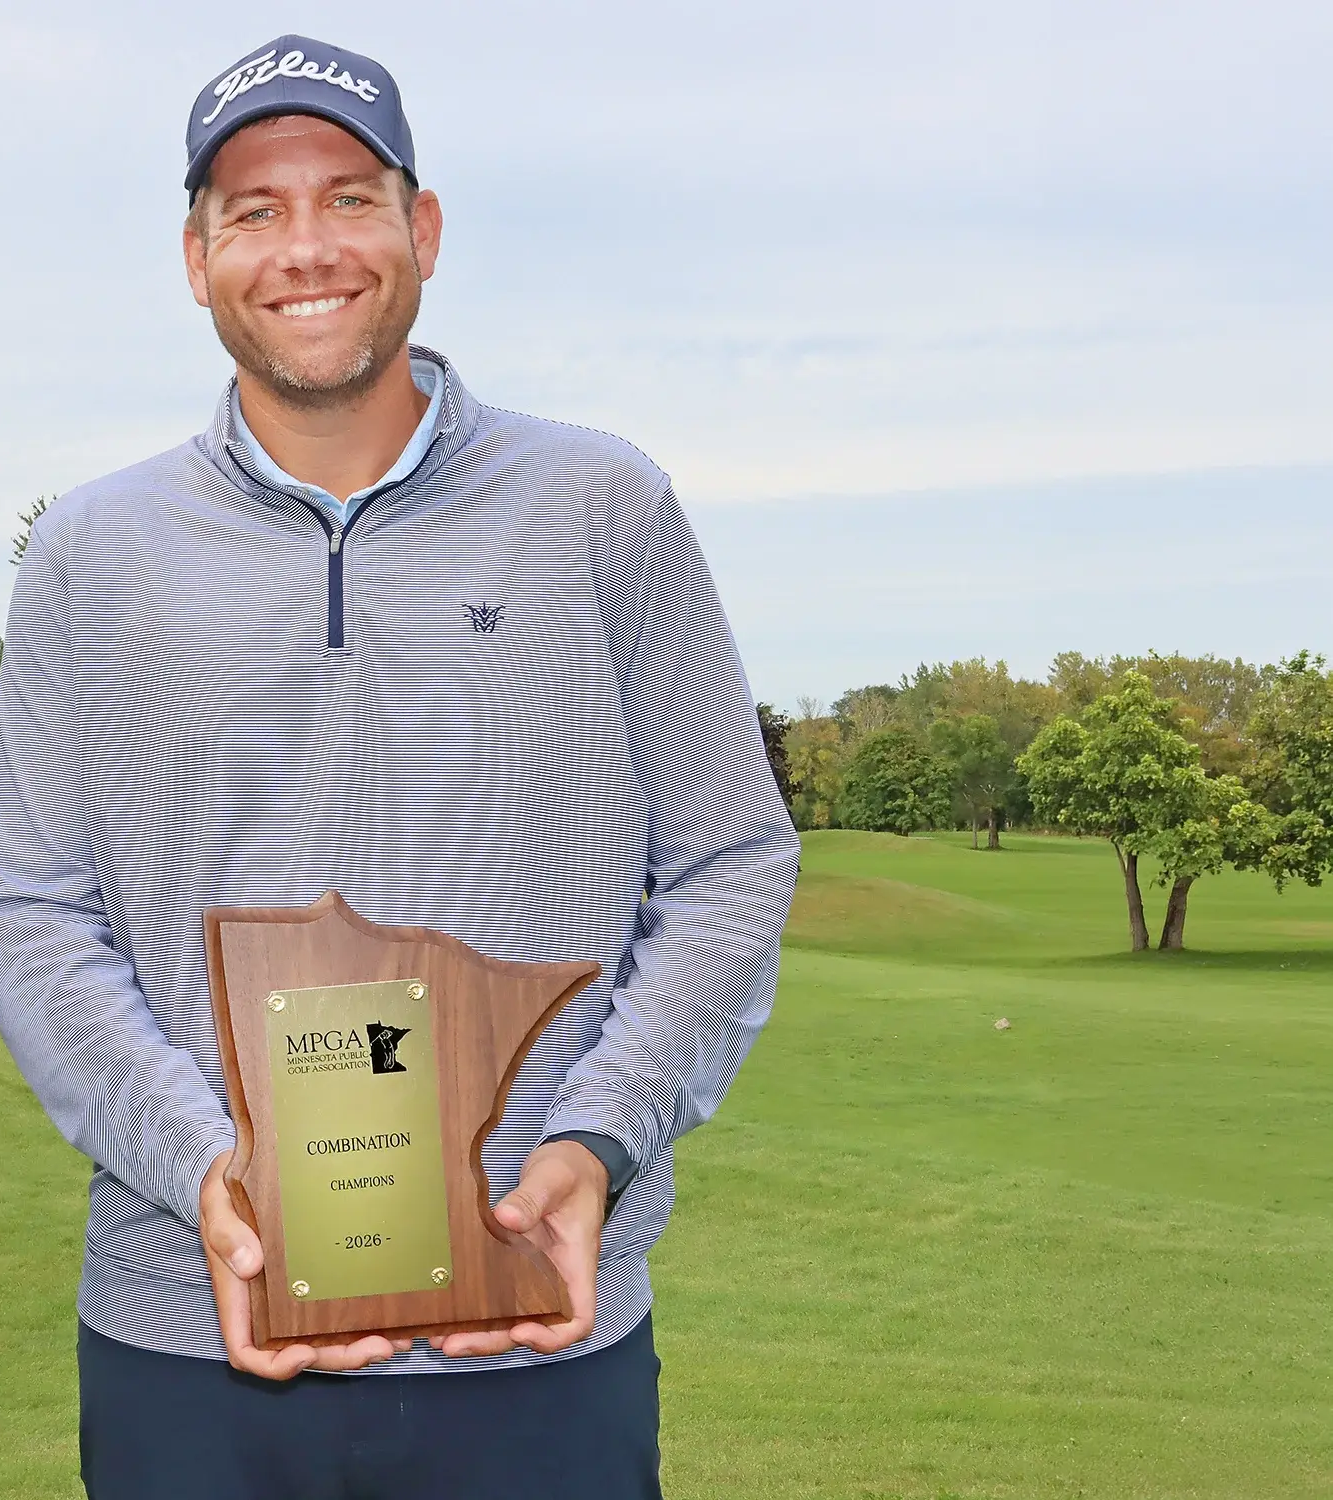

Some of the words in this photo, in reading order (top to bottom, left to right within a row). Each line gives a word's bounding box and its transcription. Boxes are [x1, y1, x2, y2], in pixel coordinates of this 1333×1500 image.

[202, 50, 380, 126] Titleist
[285, 1029, 364, 1055] MPGA
[287, 1054, 338, 1066] MINNESOTA
[339, 1050, 369, 1061] PUBLIC
[287, 1065, 310, 1075] GOLF
[312, 1060, 370, 1074] ASSOCIATION
[307, 1132, 411, 1156] COMBINATION
[330, 1175, 395, 1191] CHAMPIONS
[345, 1233, 382, 1249] 2026
